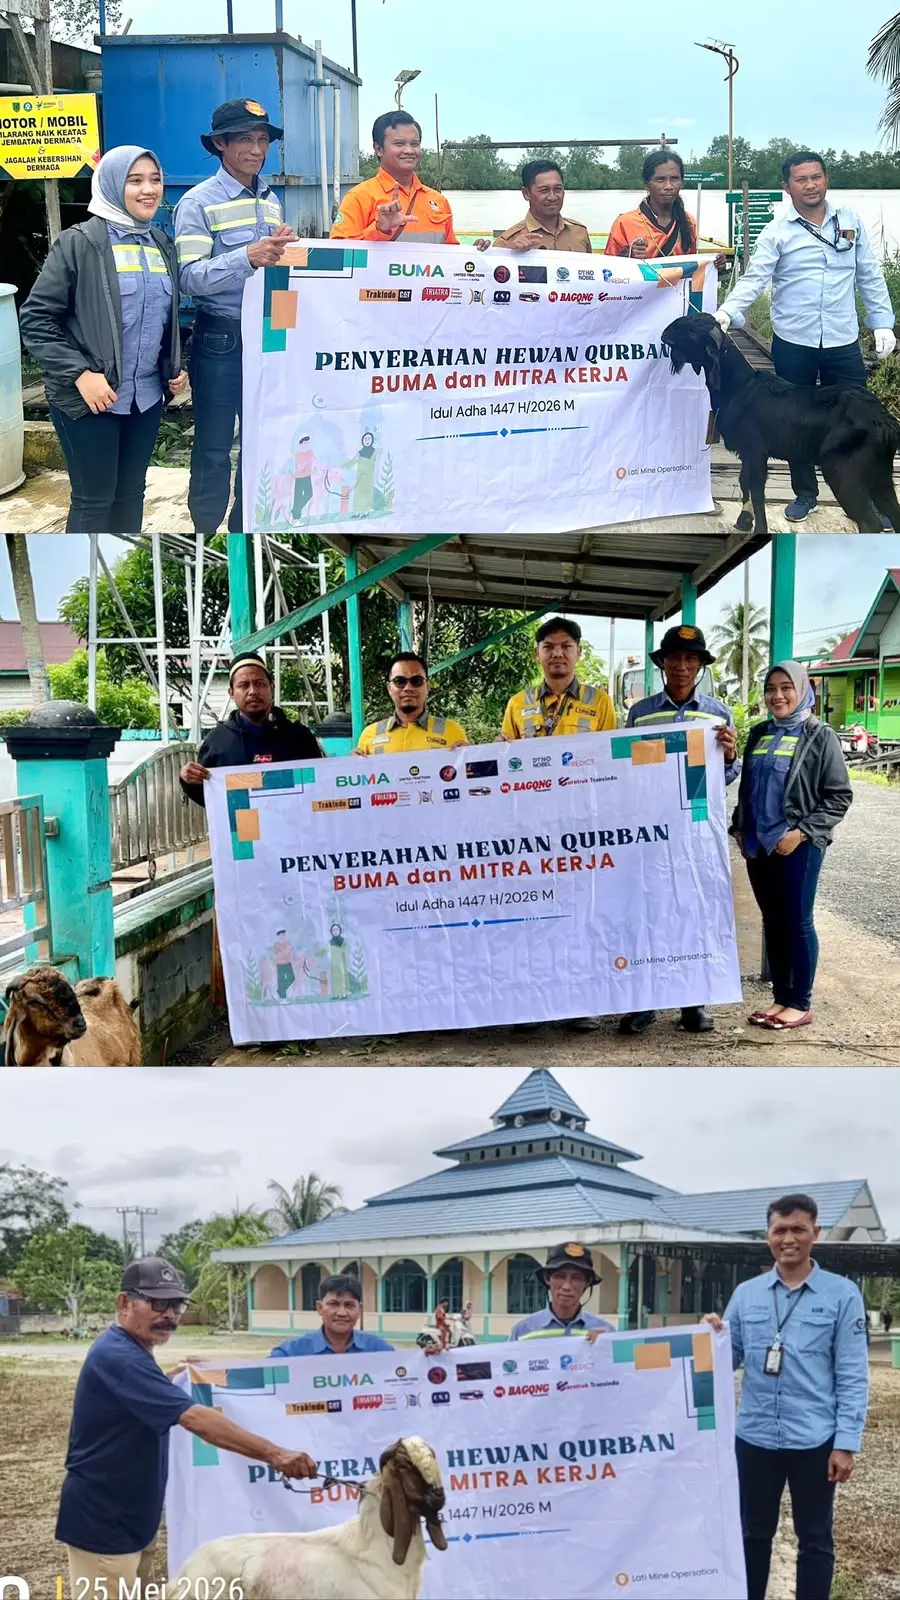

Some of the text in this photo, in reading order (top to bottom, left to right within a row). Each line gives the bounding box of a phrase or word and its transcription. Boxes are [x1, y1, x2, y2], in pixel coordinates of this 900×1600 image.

[0, 116, 88, 129] OTOR / MOBIL
[0, 130, 34, 139] ILARANG
[1, 137, 82, 146] JEMBATAN DERMAGA
[38, 146, 46, 155] &
[4, 155, 82, 164] JAGALAH KEBERSIHAN
[26, 164, 60, 172] DERMAGA
[388, 263, 445, 278] BUMA
[366, 290, 396, 299] Trakindo
[399, 290, 411, 299] CAT
[425, 288, 449, 296] TRIATRA
[560, 292, 594, 302] BAGONG
[314, 343, 672, 371] PENYERAHAN HEWAN QURBAN
[371, 366, 629, 394] BUMA dan MITRA KERJA
[430, 399, 575, 420] Idul Adha 1447 H/2026 M
[627, 467, 640, 476] Lati
[640, 467, 656, 475] Mine
[336, 772, 390, 788] BUMA
[513, 779, 552, 792] BAGONG
[318, 800, 347, 809] Trakindo
[279, 824, 670, 873] PENYERAHAN HEWAN QURBAN
[333, 852, 615, 891] BUMA dan MITRA KERJA
[395, 889, 554, 913] Idul Adha 1447 H/2026 M
[630, 958, 645, 966] Lati
[646, 956, 666, 964] Mine
[312, 1373, 374, 1389] BUMA
[508, 1383, 550, 1396] BAGONG
[446, 1442, 549, 1468] HEWAN
[559, 1433, 675, 1463] QURBAN
[310, 1462, 617, 1505] BUM MITRA KERJA
[448, 1506, 478, 1521] 1447
[482, 1502, 535, 1518] H/2026
[539, 1500, 552, 1514] M
[648, 1572, 670, 1580] Mine
